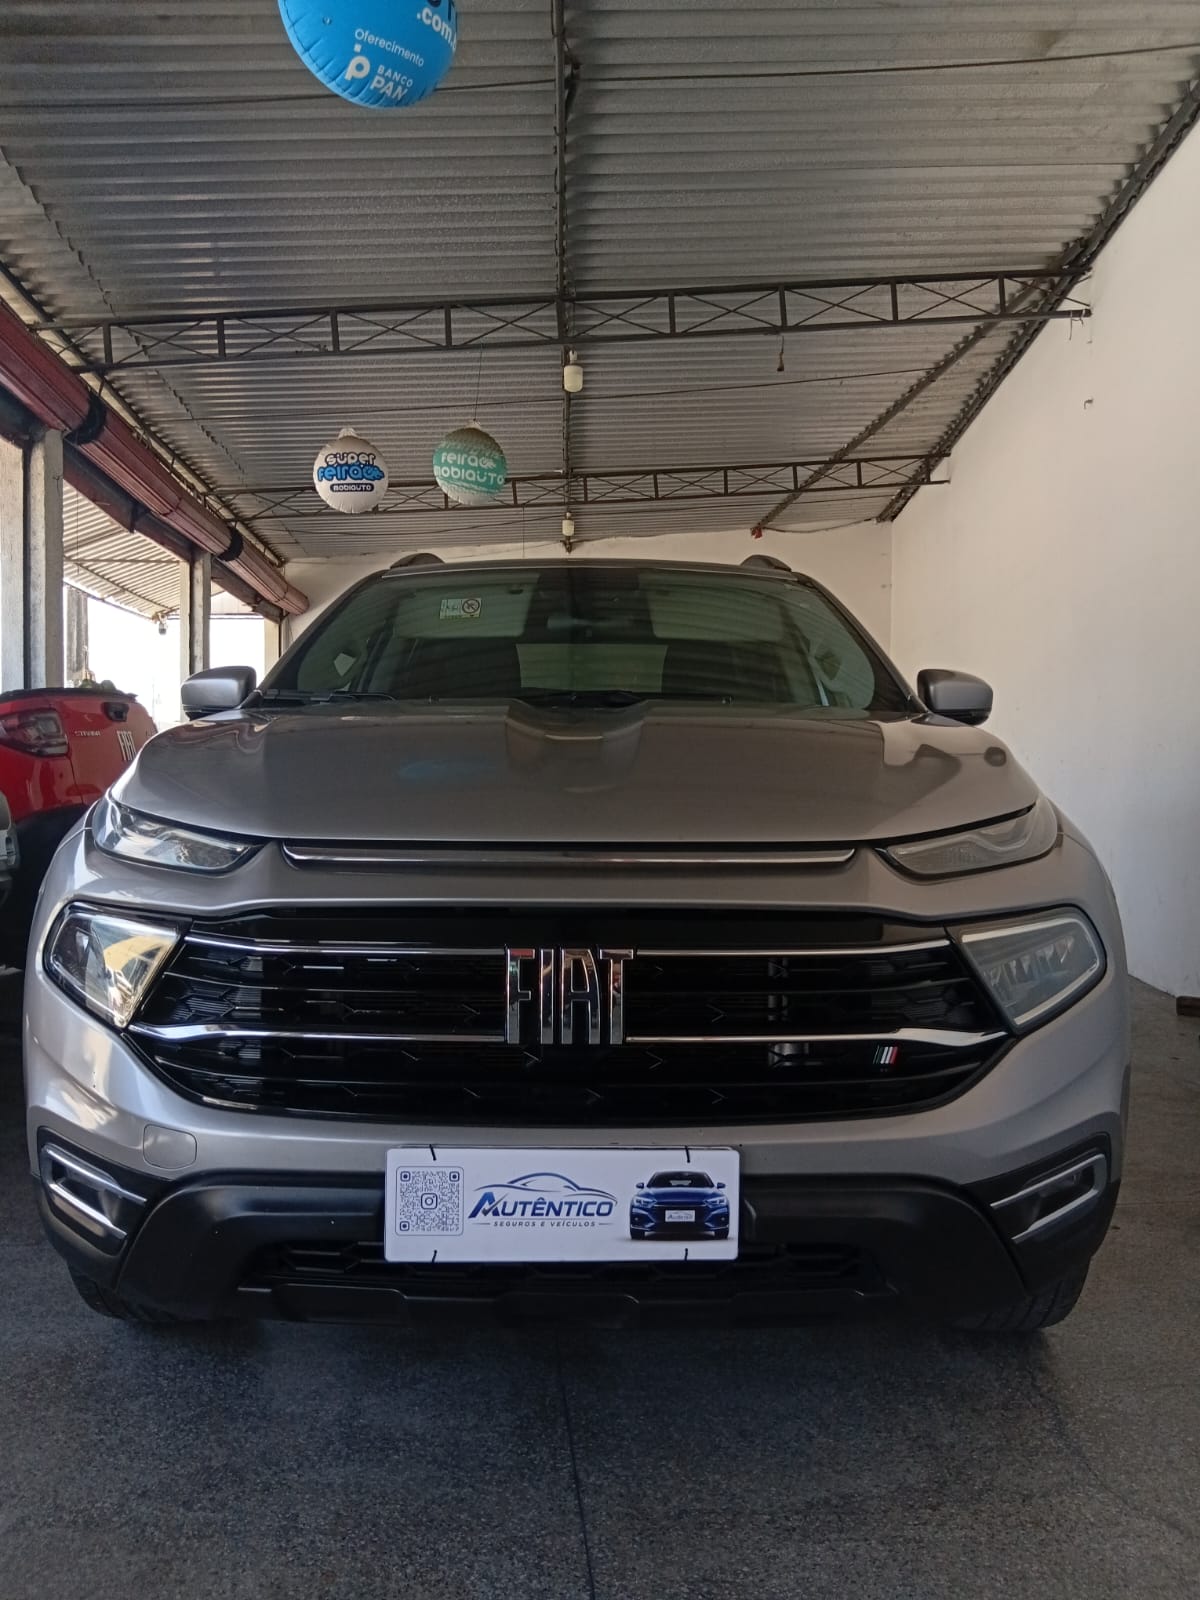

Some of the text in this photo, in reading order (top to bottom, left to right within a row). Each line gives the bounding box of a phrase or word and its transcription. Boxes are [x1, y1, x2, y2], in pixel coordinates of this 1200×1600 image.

[354, 28, 424, 67] Oferecimento
[369, 75, 408, 100] PAN
[377, 64, 413, 88] BANCO
[506, 948, 634, 1045] FIAT
[468, 1191, 614, 1218] AUTÊNTICO
[493, 1219, 597, 1228] SEGUROS E VEÍCULOS
